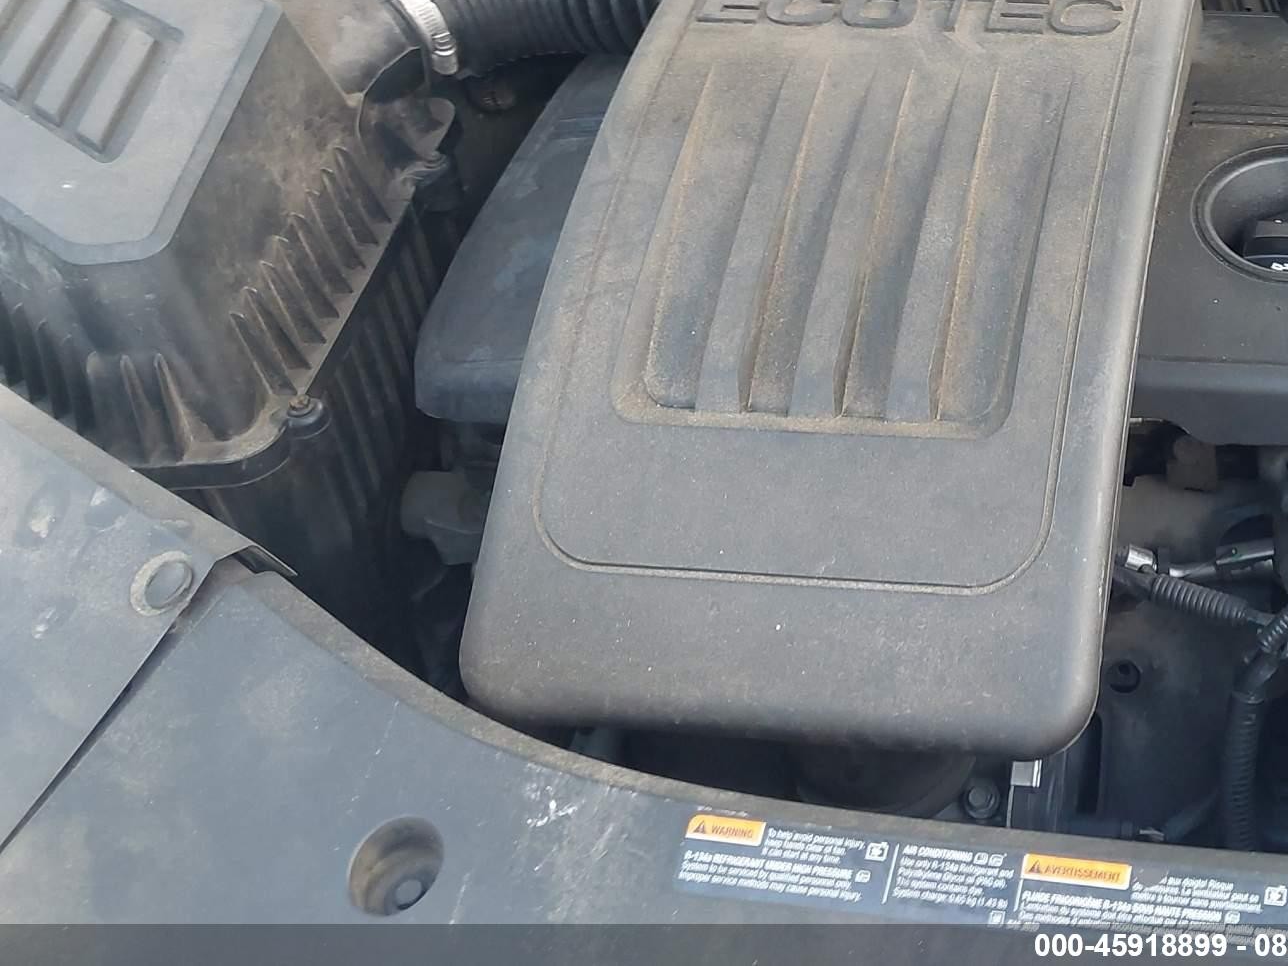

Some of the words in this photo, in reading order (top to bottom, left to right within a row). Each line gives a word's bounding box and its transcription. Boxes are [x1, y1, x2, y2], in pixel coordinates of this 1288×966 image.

[711, 825, 754, 838] WARNING
[902, 844, 918, 856] AIR
[918, 846, 974, 862] CONDITIONING
[1044, 865, 1121, 882] AVERTISSEMENT
